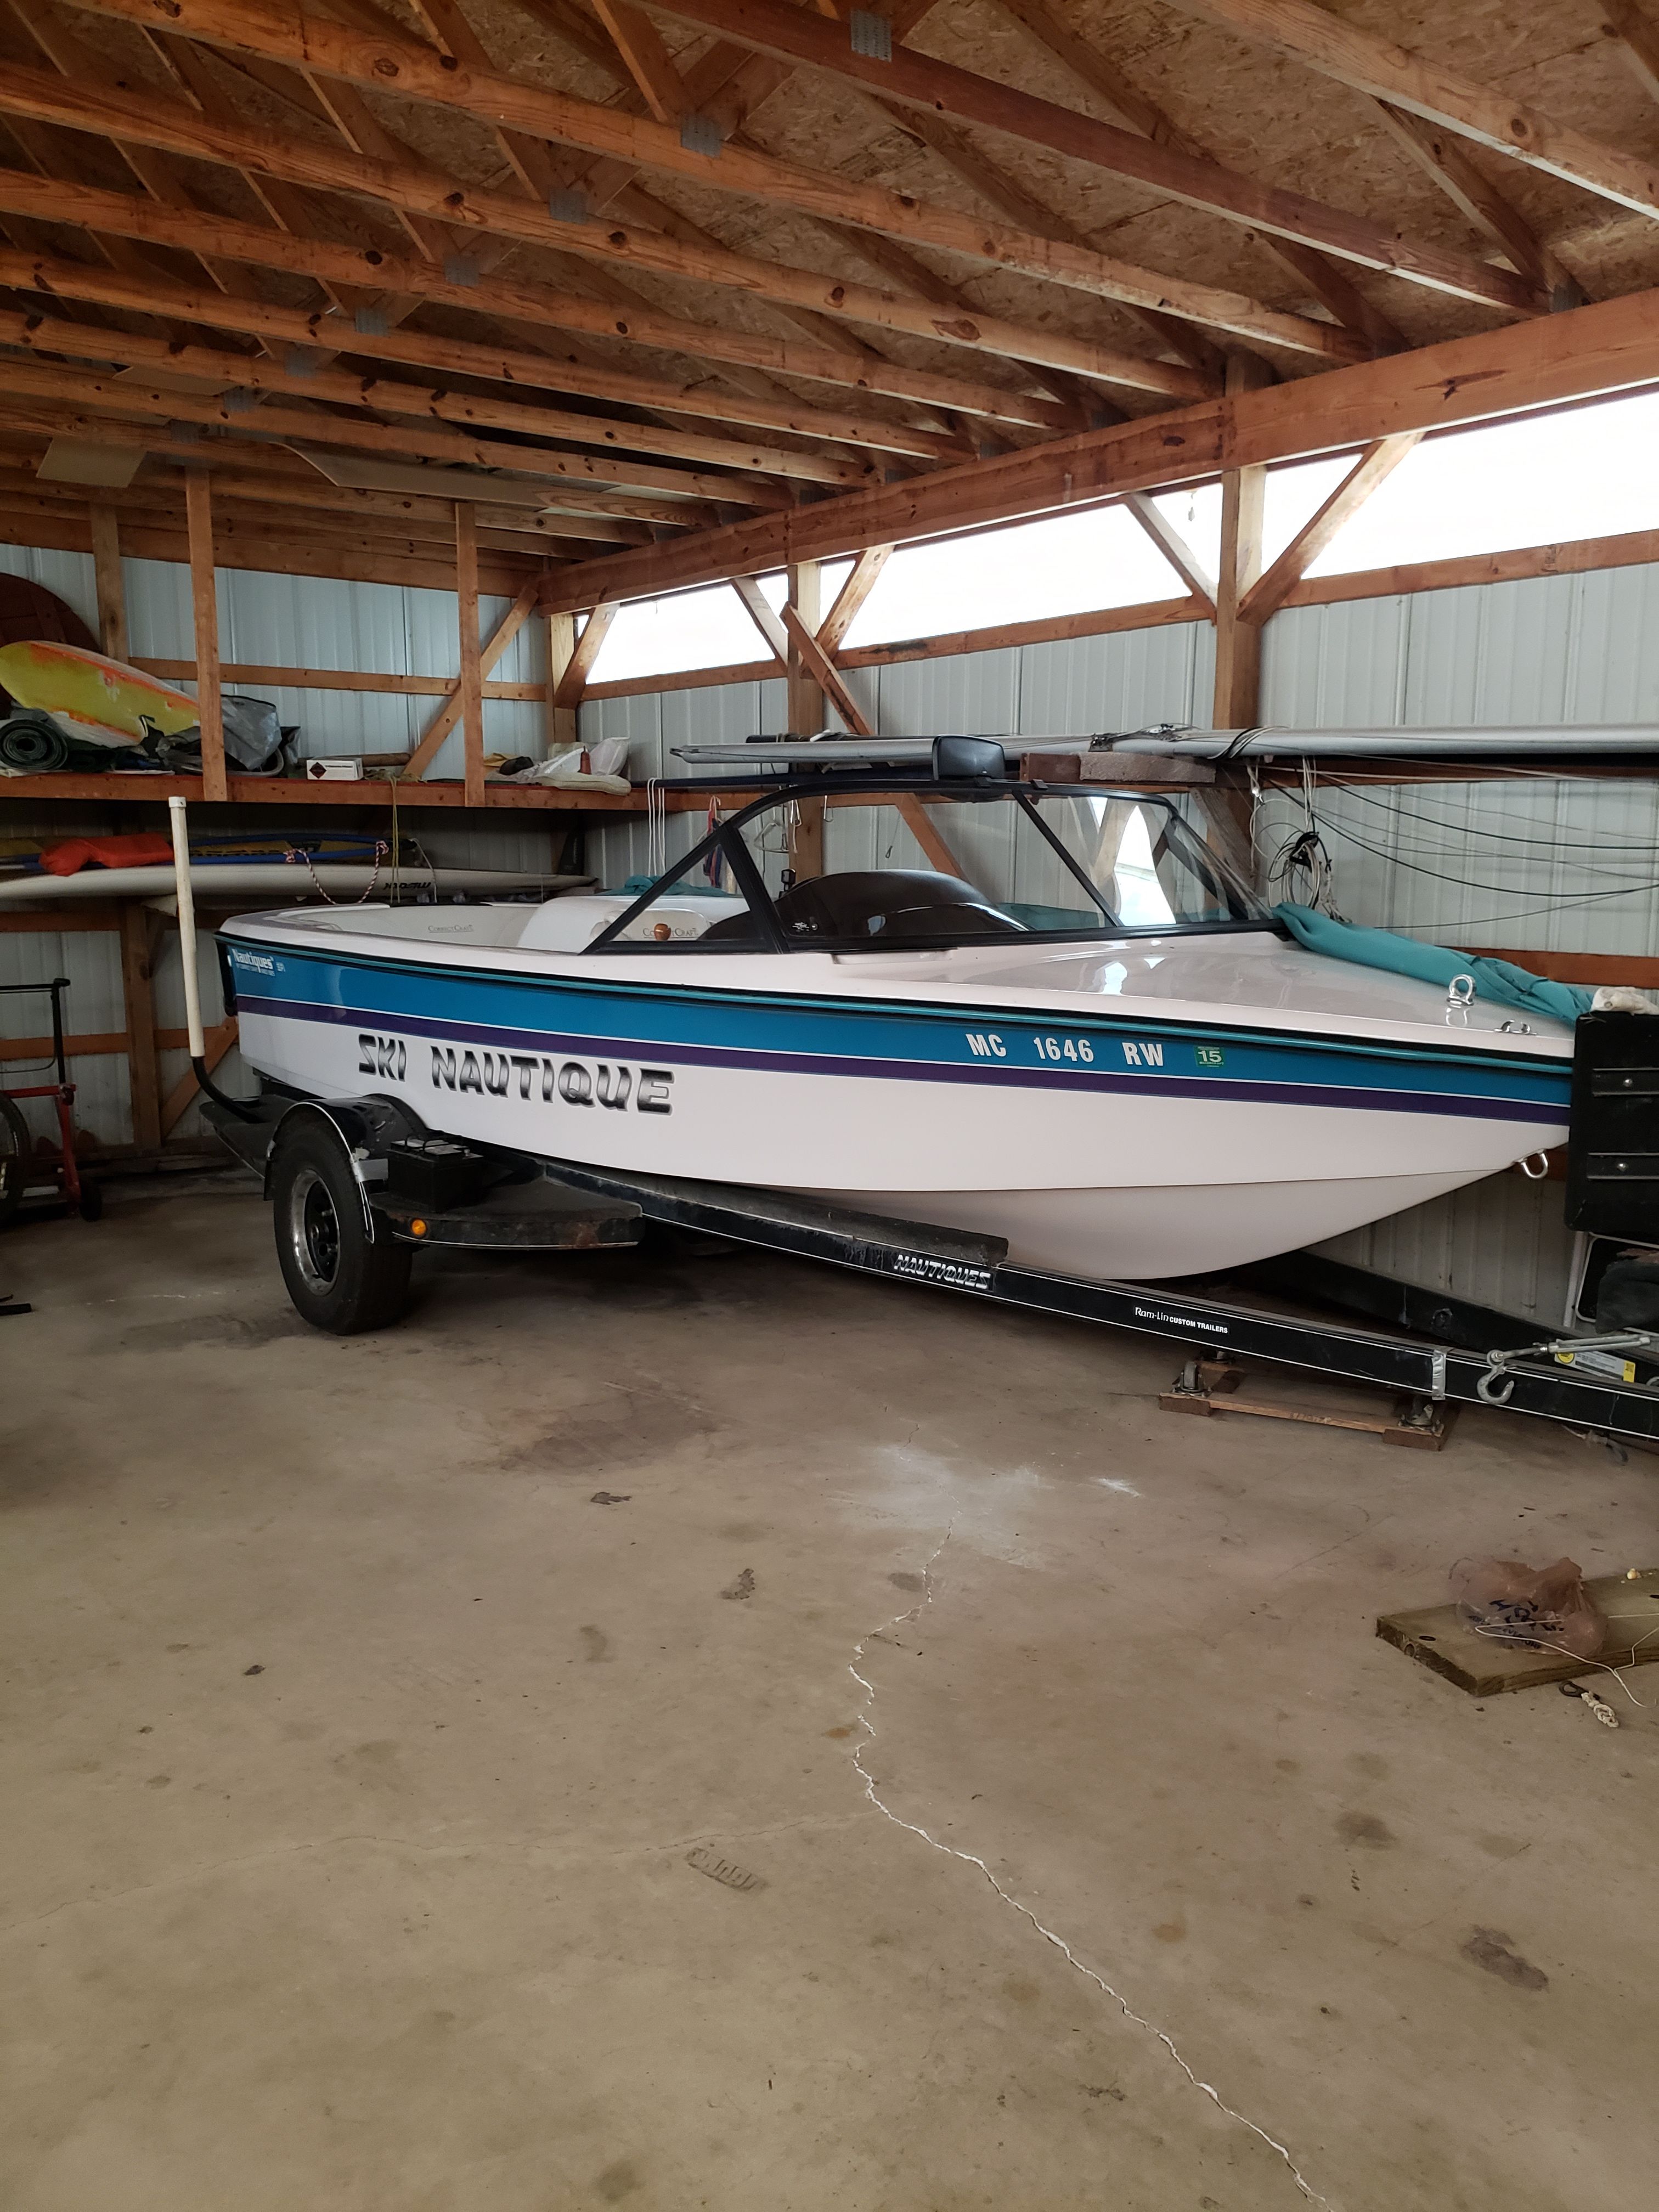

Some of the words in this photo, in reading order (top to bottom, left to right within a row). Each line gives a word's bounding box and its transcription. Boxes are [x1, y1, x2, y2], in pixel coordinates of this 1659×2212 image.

[232, 949, 273, 973] Nautiques
[966, 1034, 1006, 1057] MC
[1034, 1036, 1094, 1063] 1646
[1122, 1042, 1164, 1066] RW
[1198, 1050, 1222, 1063] 15
[358, 1034, 407, 1082] SKI
[430, 1045, 675, 1116] NAUTIQUE
[894, 1254, 991, 1289] NAUTIQUES
[1135, 1307, 1169, 1322] Ram-Lin
[1169, 1318, 1196, 1327] CUSTOM
[1197, 1322, 1228, 1334] TRAILERS
